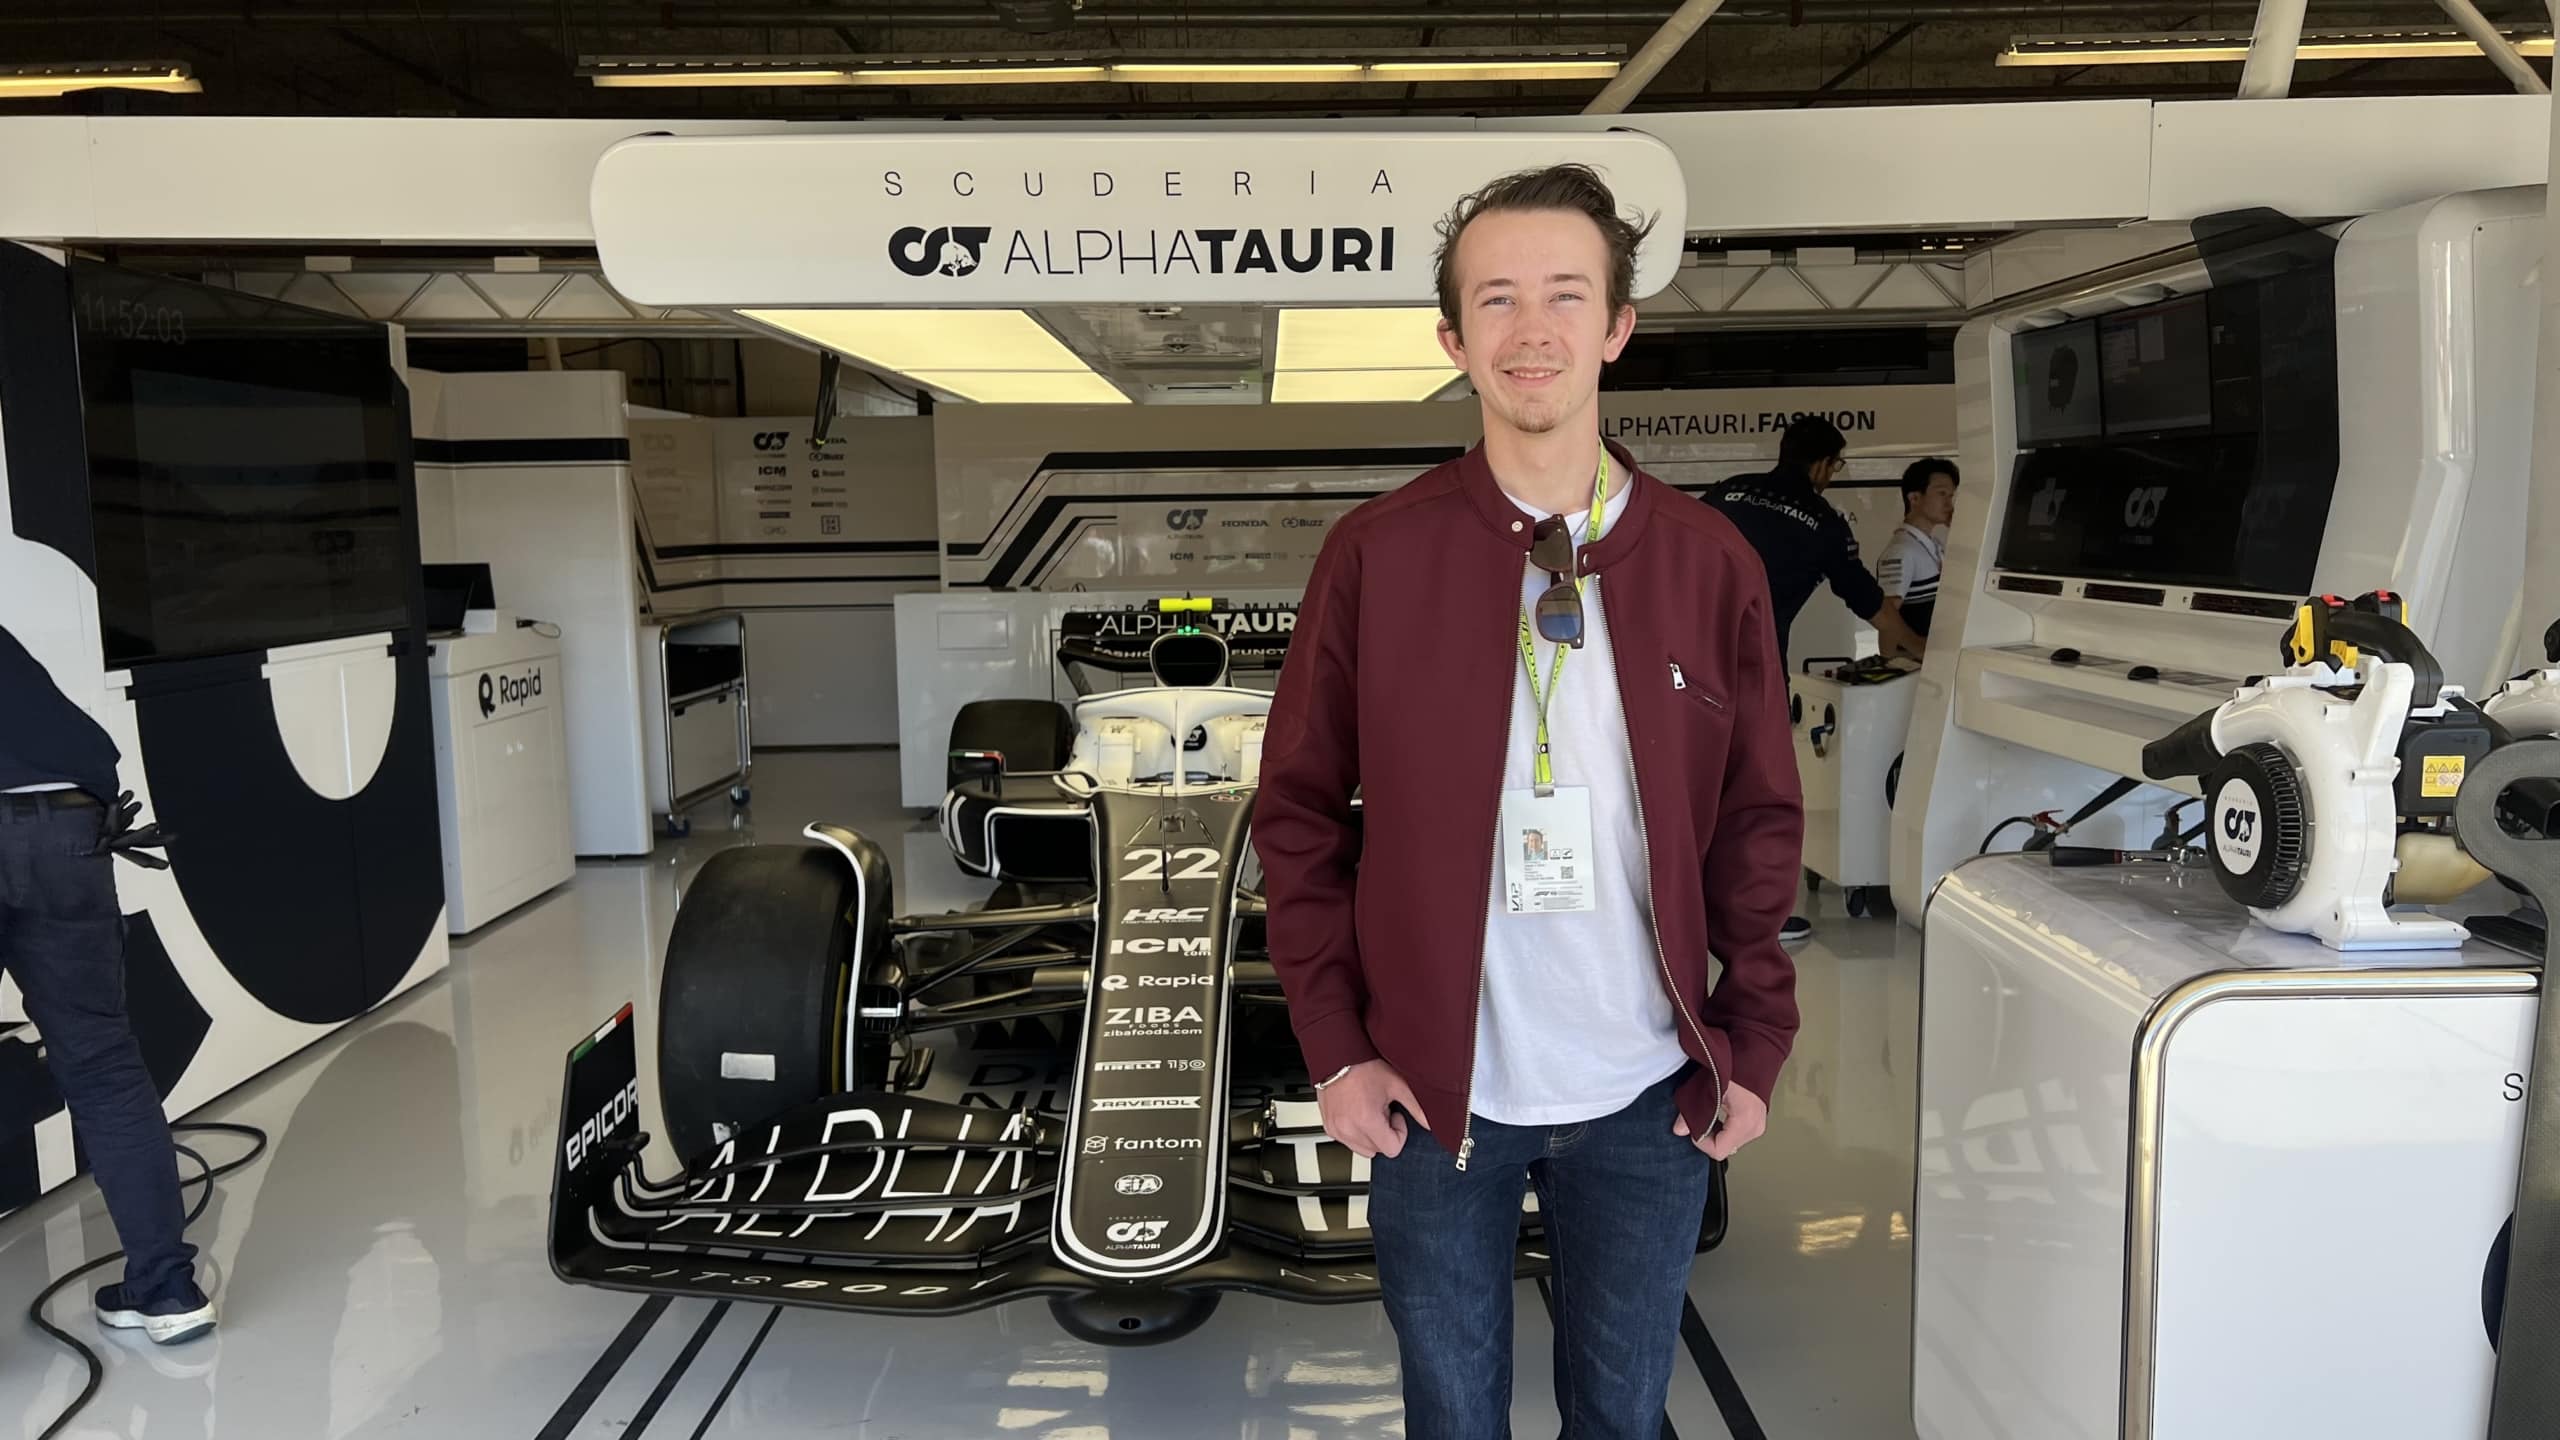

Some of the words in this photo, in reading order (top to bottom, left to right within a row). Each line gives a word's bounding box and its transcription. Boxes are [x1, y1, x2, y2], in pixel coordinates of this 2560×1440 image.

[883, 169, 1394, 197] SCUDERIA
[1003, 226, 1395, 275] ALPHATAURI
[758, 466, 787, 476] ICM
[1221, 520, 1269, 528] HONDA
[1299, 519, 1325, 527] Buzz
[1169, 553, 1194, 561] ICM
[499, 667, 542, 707] Rapid
[1119, 847, 1221, 881] 22
[1122, 907, 1210, 920] HRC
[1109, 937, 1212, 955] ICM
[1138, 974, 1215, 988] Rapid
[1104, 1006, 1203, 1025] ZIBA
[1102, 1027, 1203, 1038] zibafoods.com
[1094, 1060, 1162, 1072] PIRELLI
[1101, 1098, 1192, 1108] RAVENOL
[1113, 1137, 1203, 1150] fantom
[1117, 1177, 1159, 1192] FIA
